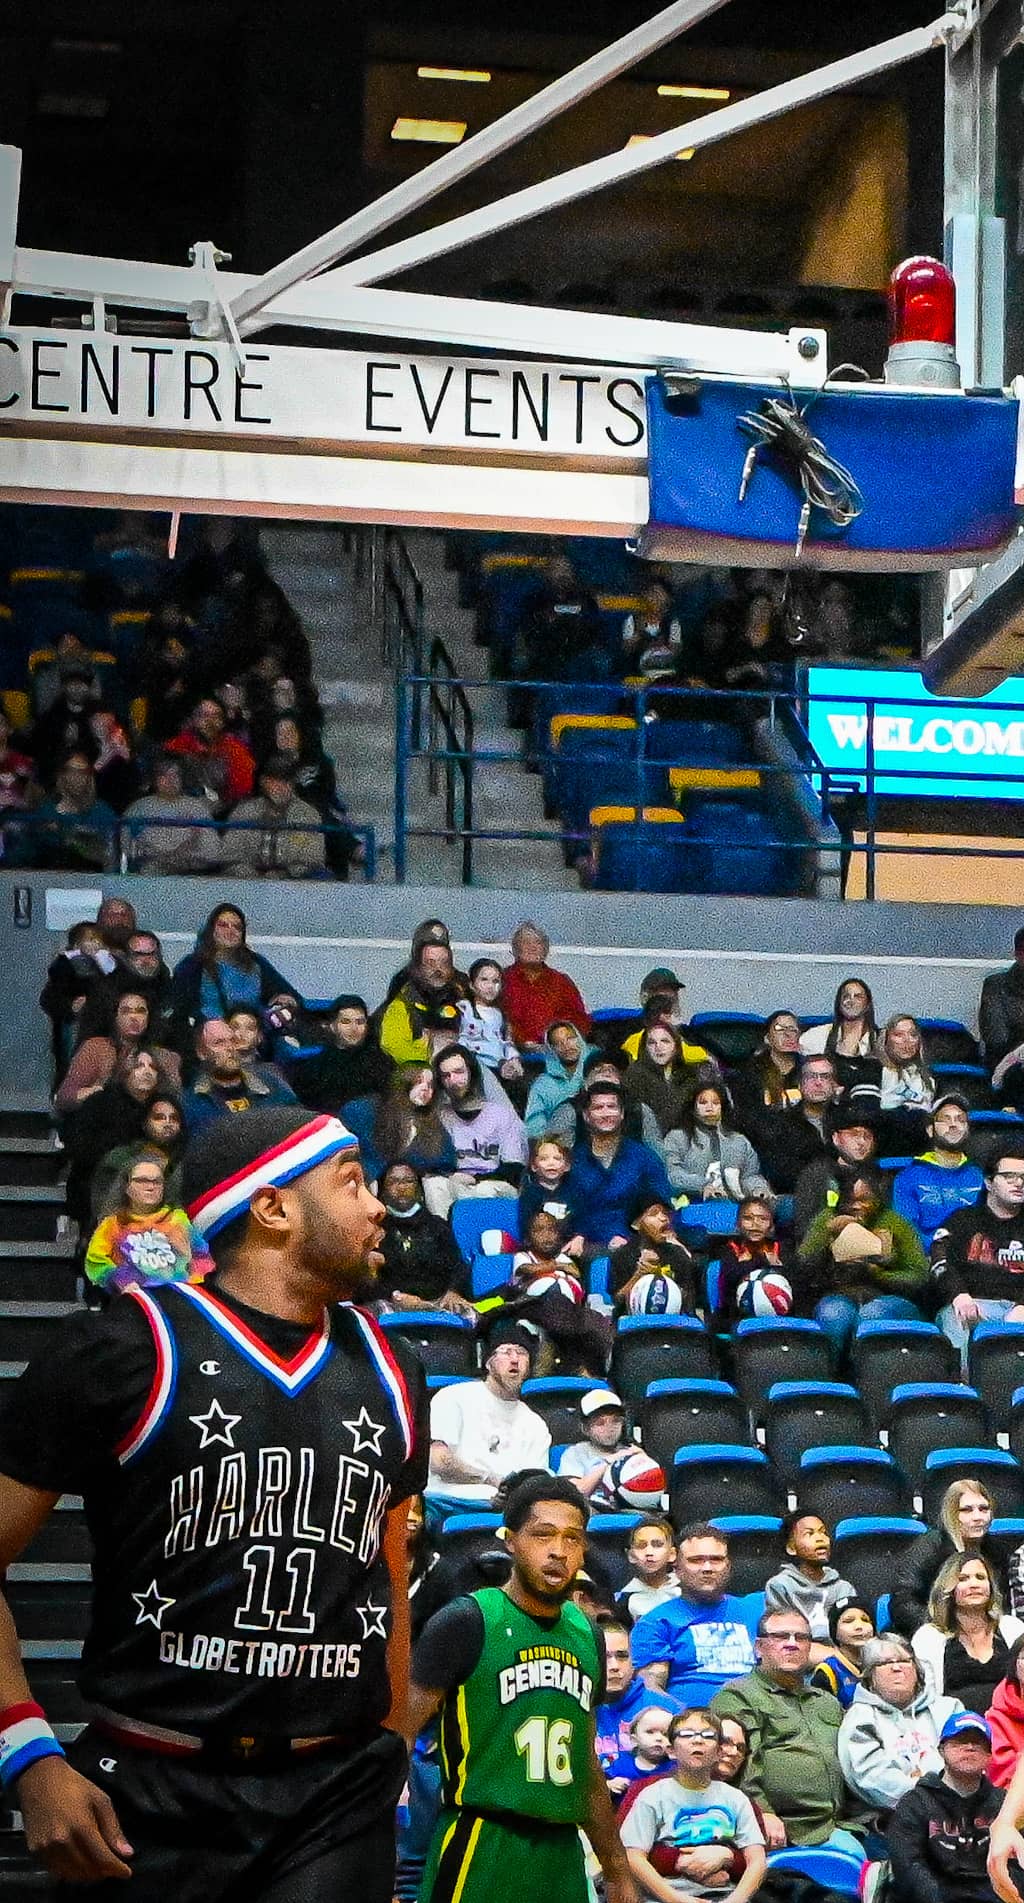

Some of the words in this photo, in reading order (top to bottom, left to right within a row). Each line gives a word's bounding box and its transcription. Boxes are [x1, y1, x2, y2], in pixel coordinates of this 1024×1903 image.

[365, 361, 645, 447] EVENTS
[233, 1544, 316, 1634] 11
[159, 1631, 362, 1679] GLOBETROTTERS
[499, 1658, 593, 1713] GENERALS
[514, 1715, 574, 1787] 16
